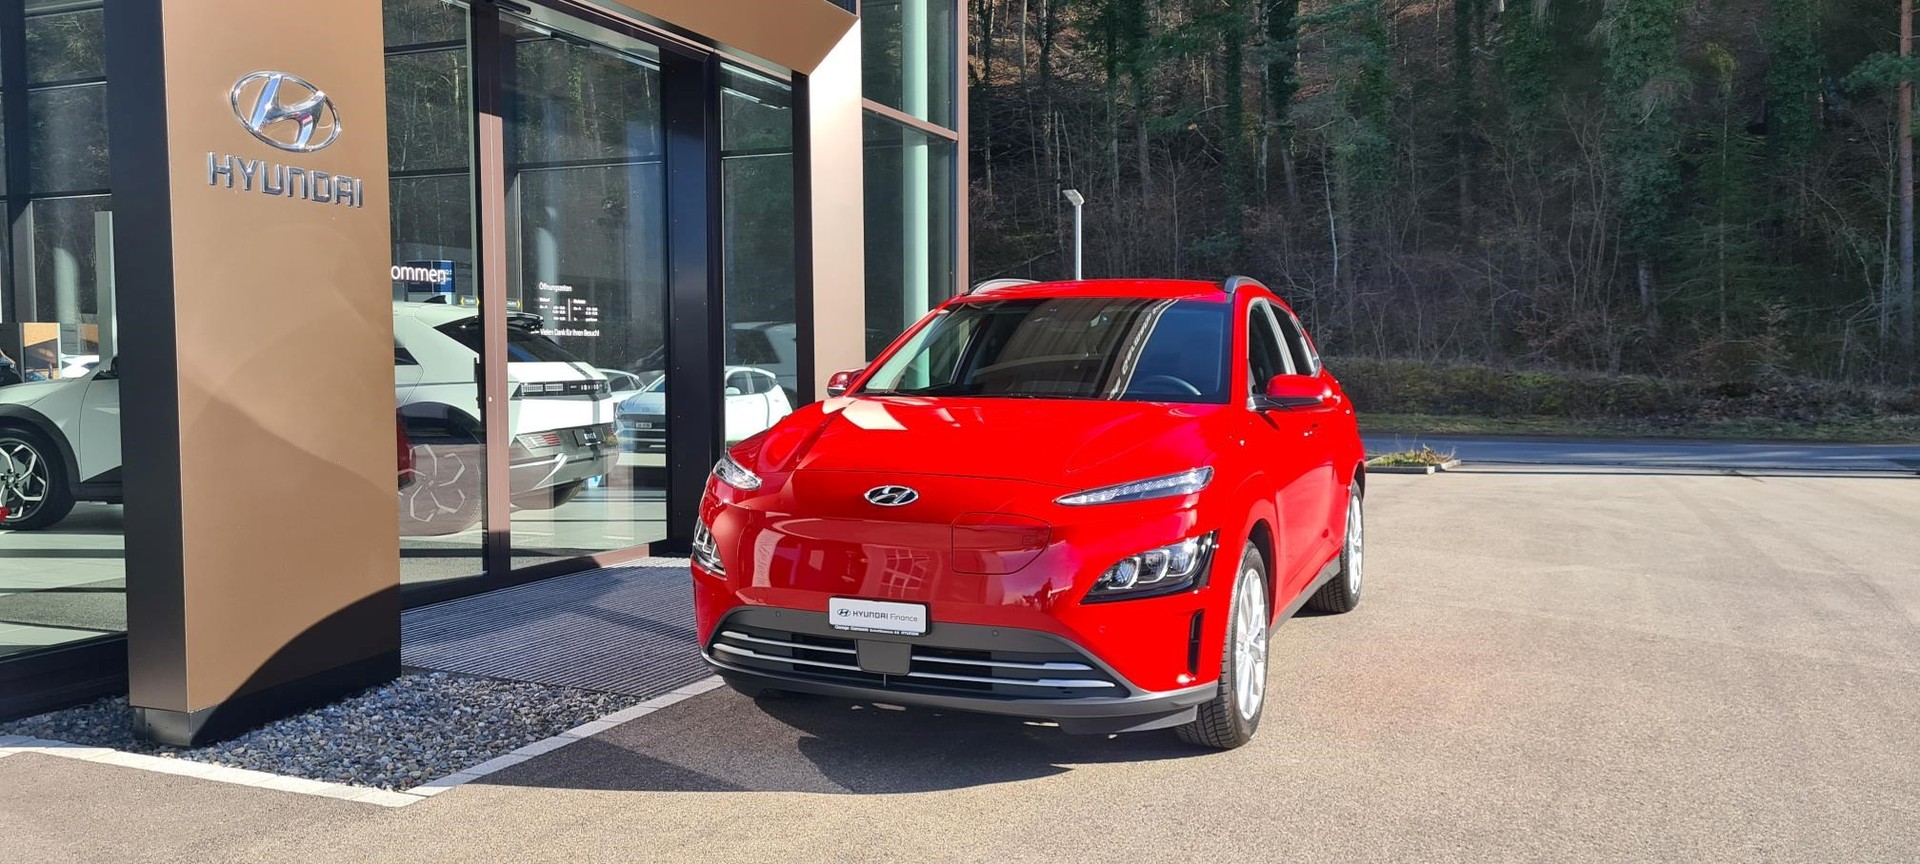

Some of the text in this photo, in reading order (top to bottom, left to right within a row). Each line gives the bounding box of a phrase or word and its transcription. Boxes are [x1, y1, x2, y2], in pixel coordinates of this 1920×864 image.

[207, 151, 364, 208] HYUNDAI
[554, 328, 565, 336] Dank
[852, 610, 918, 622] HYUNDAI Finance
